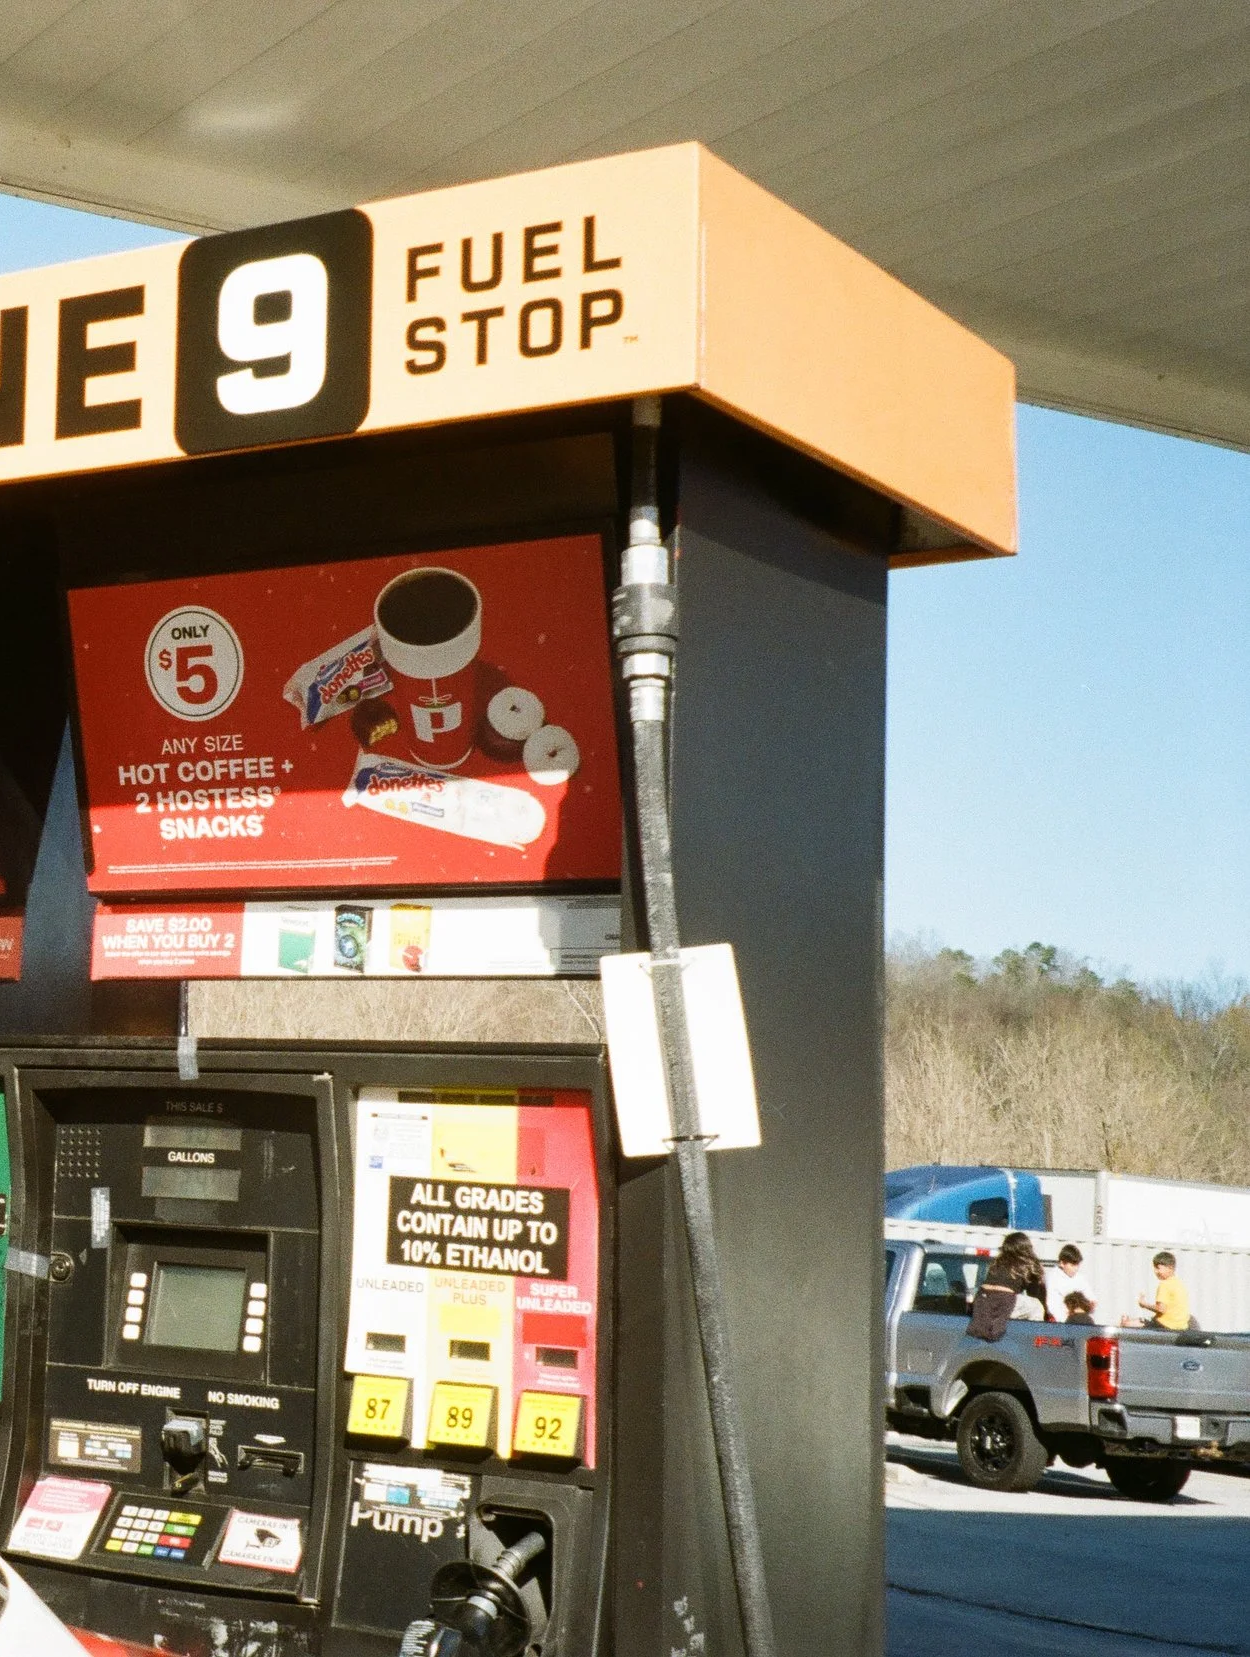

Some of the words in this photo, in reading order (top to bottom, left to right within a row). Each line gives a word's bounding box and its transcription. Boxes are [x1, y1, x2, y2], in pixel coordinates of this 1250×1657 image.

[405, 214, 622, 303] FUEL
[216, 253, 328, 415] 9
[404, 288, 624, 376] STOP
[170, 624, 210, 641] ONLY
[158, 643, 219, 705] $5
[161, 735, 199, 755] ANY
[204, 734, 244, 753] SIZE
[117, 763, 170, 786] HOT
[177, 757, 276, 783] COFFEE
[281, 759, 294, 774] +
[367, 772, 446, 796] donettes
[135, 792, 152, 814] 2
[125, 918, 165, 934] SAVE
[168, 917, 212, 934] $2.00
[101, 934, 149, 949] WHEN
[151, 934, 185, 949] YOU
[187, 933, 220, 949] BUY
[223, 932, 236, 949] 2
[189, 1102, 214, 1113] SALE
[167, 1151, 216, 1164] GALLONS
[409, 1182, 452, 1208] ALL
[454, 1185, 545, 1215] GRADES
[396, 1210, 491, 1243] CONTAIN
[492, 1219, 524, 1244] UP
[527, 1220, 558, 1246] TO
[401, 1238, 442, 1266] 10%
[446, 1241, 549, 1275] ETHANOL
[355, 1277, 425, 1294] UNLEADED
[433, 1275, 507, 1293] UNLEADED
[528, 1281, 579, 1301] SUPER
[452, 1291, 488, 1306] PLUS
[515, 1295, 593, 1316] UNLEADED
[87, 1378, 116, 1393] TURN
[118, 1383, 139, 1396] OFF
[141, 1385, 181, 1399] ENGINE
[208, 1390, 225, 1404] NO
[226, 1392, 280, 1410] SMOKING
[365, 1398, 391, 1421] 87
[446, 1406, 474, 1430] 89
[534, 1416, 563, 1441] 92
[350, 1501, 444, 1543] Pump
